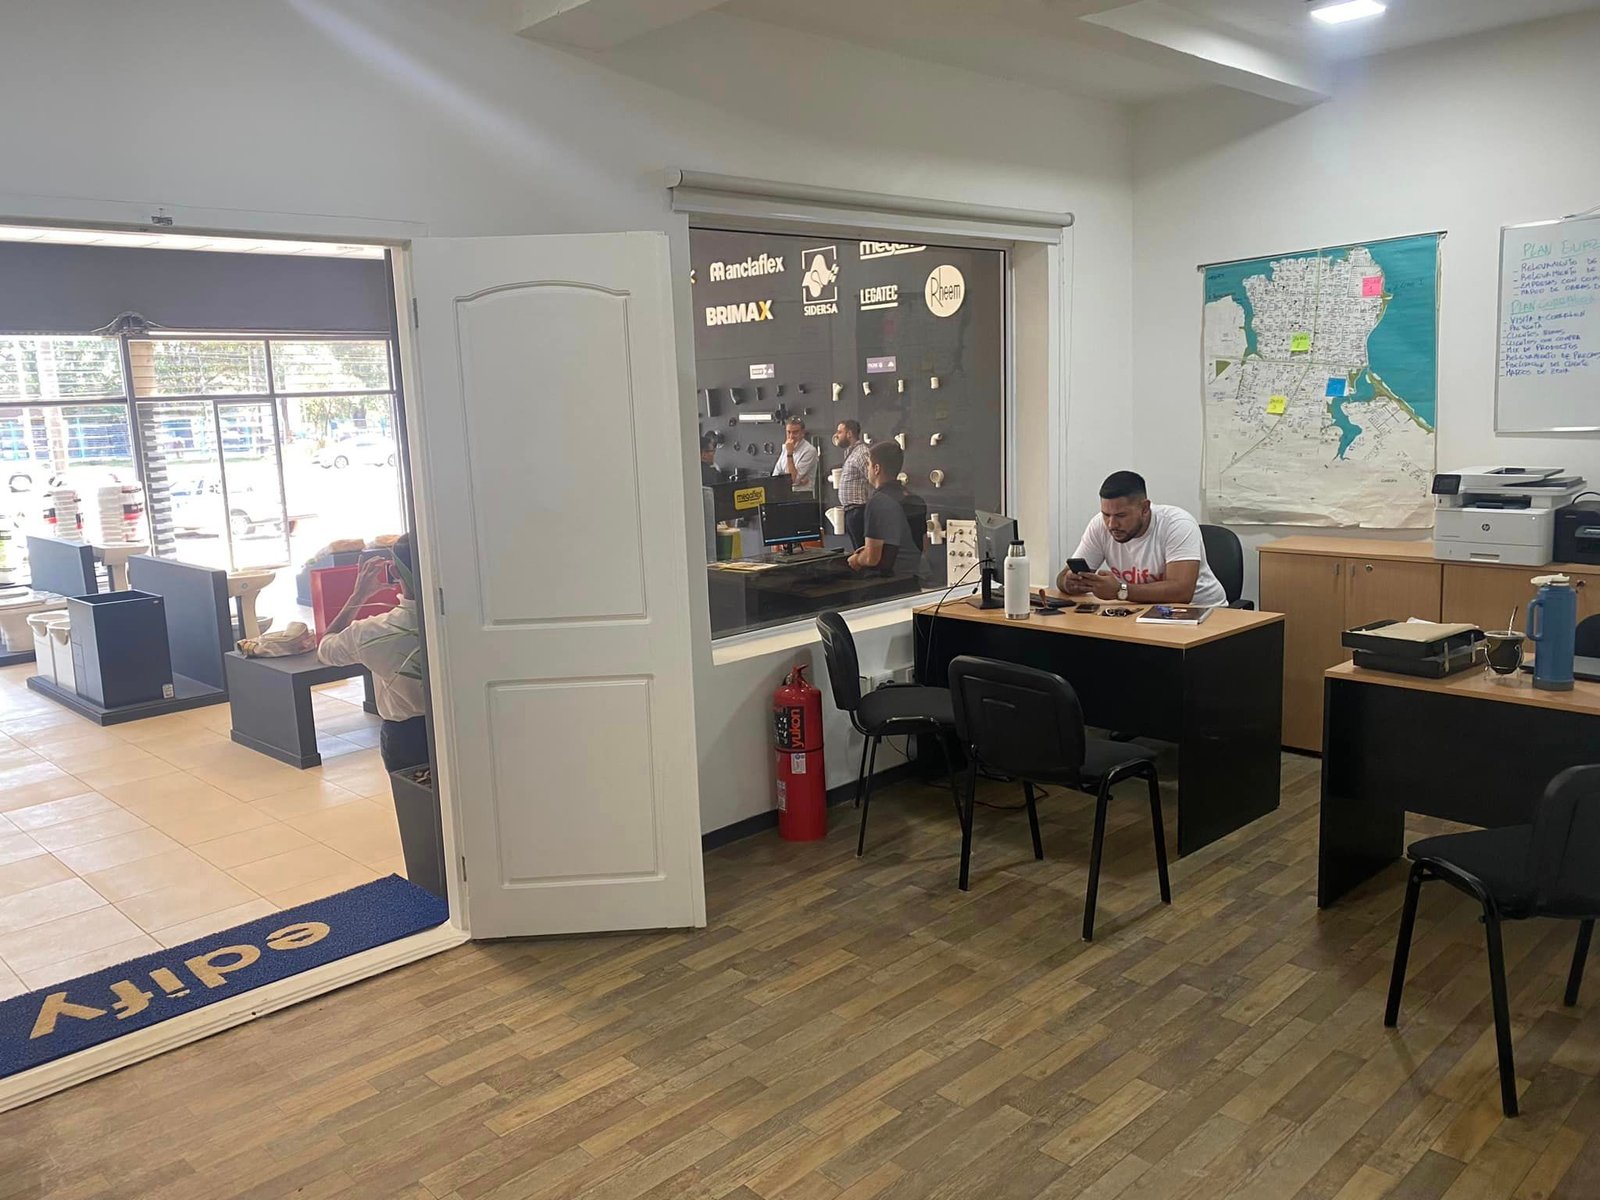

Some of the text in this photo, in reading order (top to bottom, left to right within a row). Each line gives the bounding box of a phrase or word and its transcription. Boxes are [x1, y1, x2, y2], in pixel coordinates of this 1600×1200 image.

[860, 284, 898, 304] LEGATEC
[930, 267, 961, 308] Rheem
[705, 300, 774, 326] BRIMAX
[803, 303, 838, 316] SIDERSA
[790, 709, 804, 748] yukon
[29, 921, 331, 1039] edify
